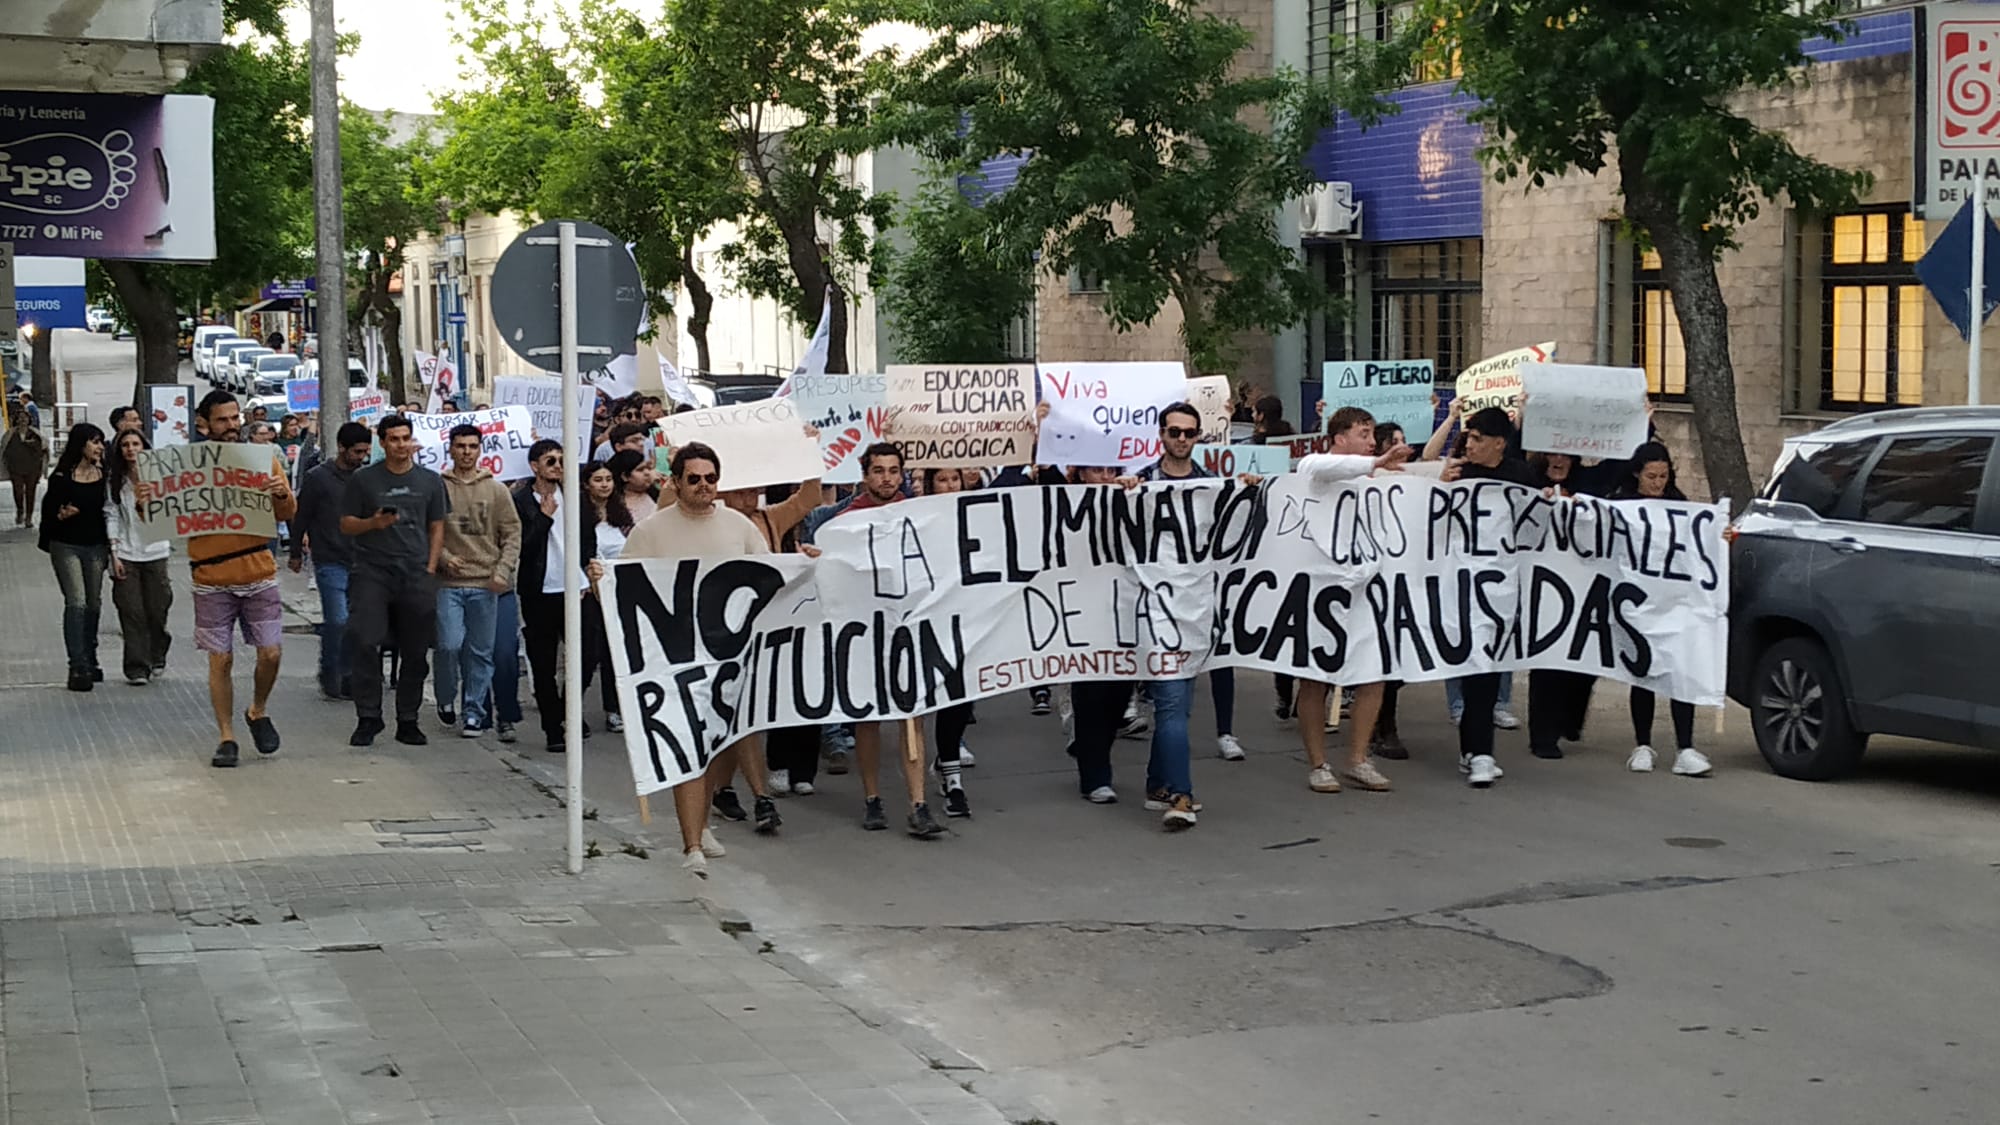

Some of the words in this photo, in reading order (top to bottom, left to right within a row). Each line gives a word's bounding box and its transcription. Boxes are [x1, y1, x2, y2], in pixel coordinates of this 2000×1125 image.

[18, 107, 27, 121] y
[29, 105, 86, 120] Lencería
[1939, 189, 1957, 201] DE
[2, 225, 36, 238] 7727
[62, 226, 77, 239] Mi
[81, 226, 103, 240] Pie
[924, 368, 1019, 392] EDUCADOR
[1046, 371, 1107, 399] Viva
[848, 403, 862, 422] de
[936, 390, 1026, 414] LUCHAR
[408, 412, 479, 431] RECORTAR
[490, 409, 510, 421] EN
[417, 446, 437, 466] ES
[507, 430, 531, 450] EL
[893, 434, 1016, 461] PEDAGÓGICA
[137, 447, 184, 480] PARA
[190, 445, 222, 469] UN
[1204, 448, 1235, 477] NO
[150, 470, 206, 498] UTURO
[148, 487, 273, 522] PRESUPUESTO
[615, 559, 785, 675] NO
[868, 516, 934, 599] LA
[1023, 580, 1089, 651] DE
[1113, 578, 1183, 651] LAS
[1212, 567, 1352, 673] ECAS
[979, 650, 1138, 692] ESTUDIANTES
